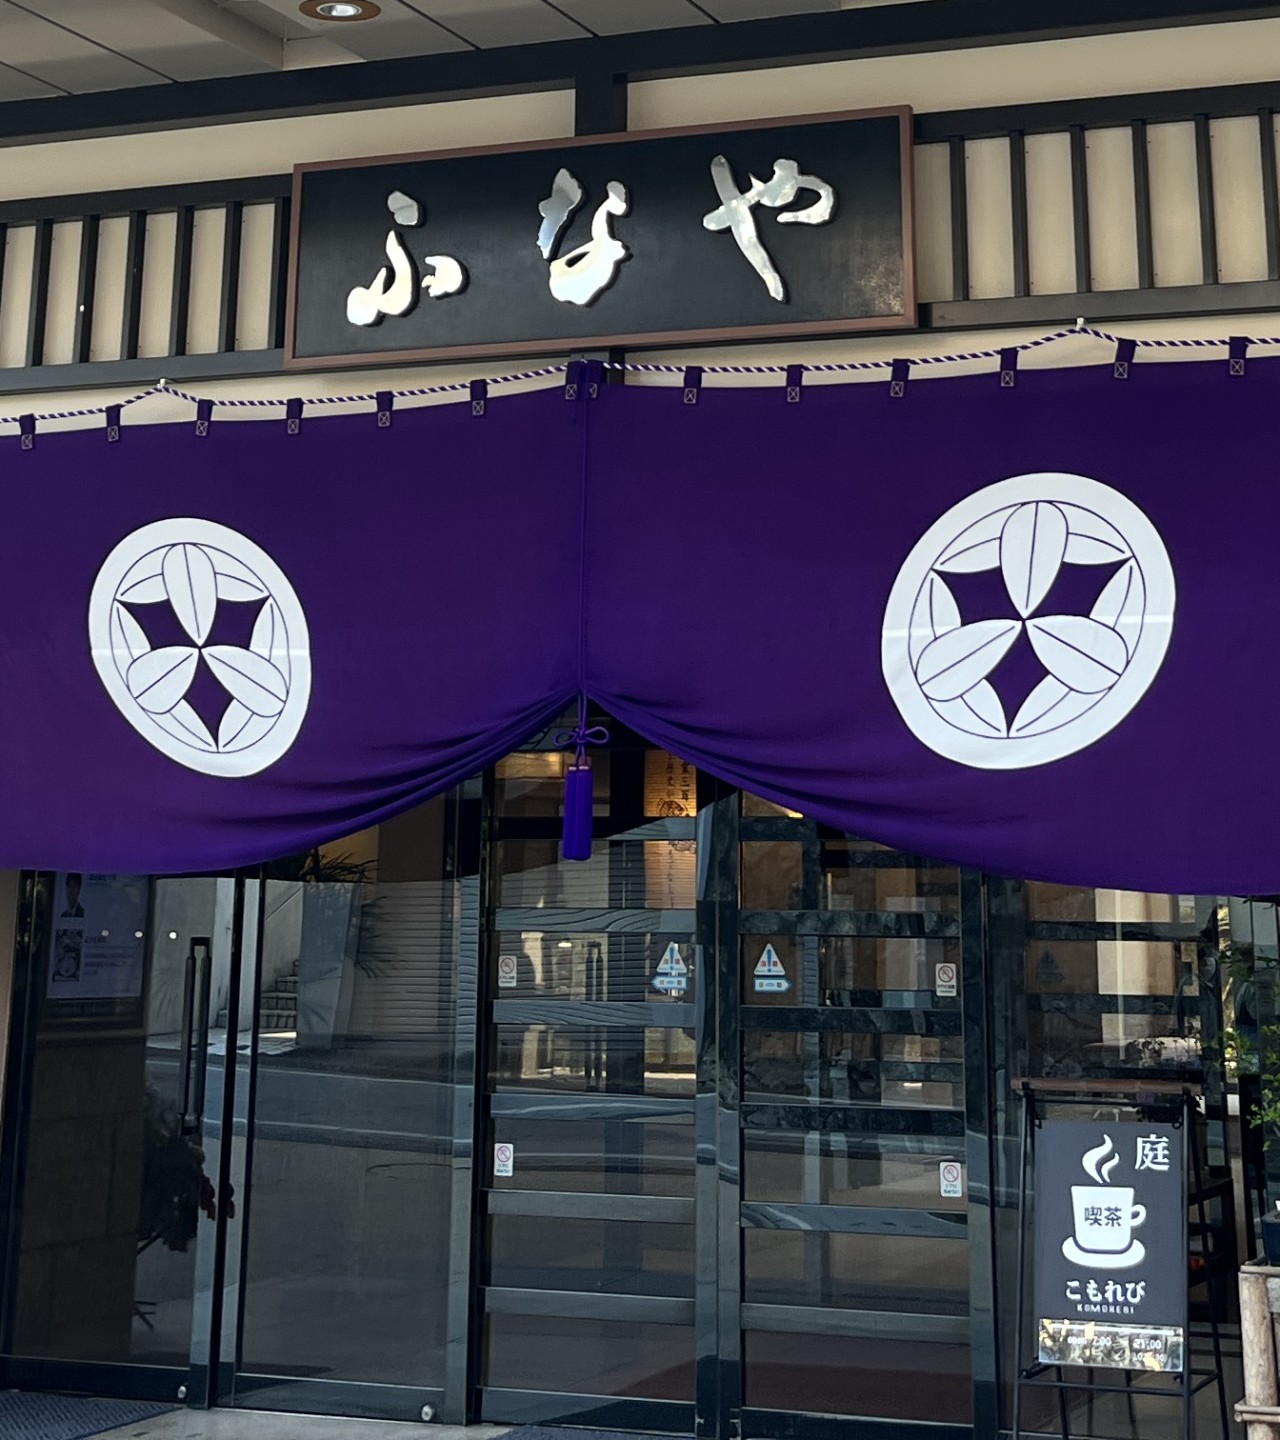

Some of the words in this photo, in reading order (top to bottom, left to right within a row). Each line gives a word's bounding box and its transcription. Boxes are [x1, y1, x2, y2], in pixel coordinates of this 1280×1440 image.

[346, 154, 837, 326] ふなや
[1135, 1134, 1170, 1171] 庭
[1084, 1206, 1122, 1227] 喫茶
[1066, 1280, 1145, 1303] こもれび
[1077, 1304, 1134, 1314] KOMOREBI
